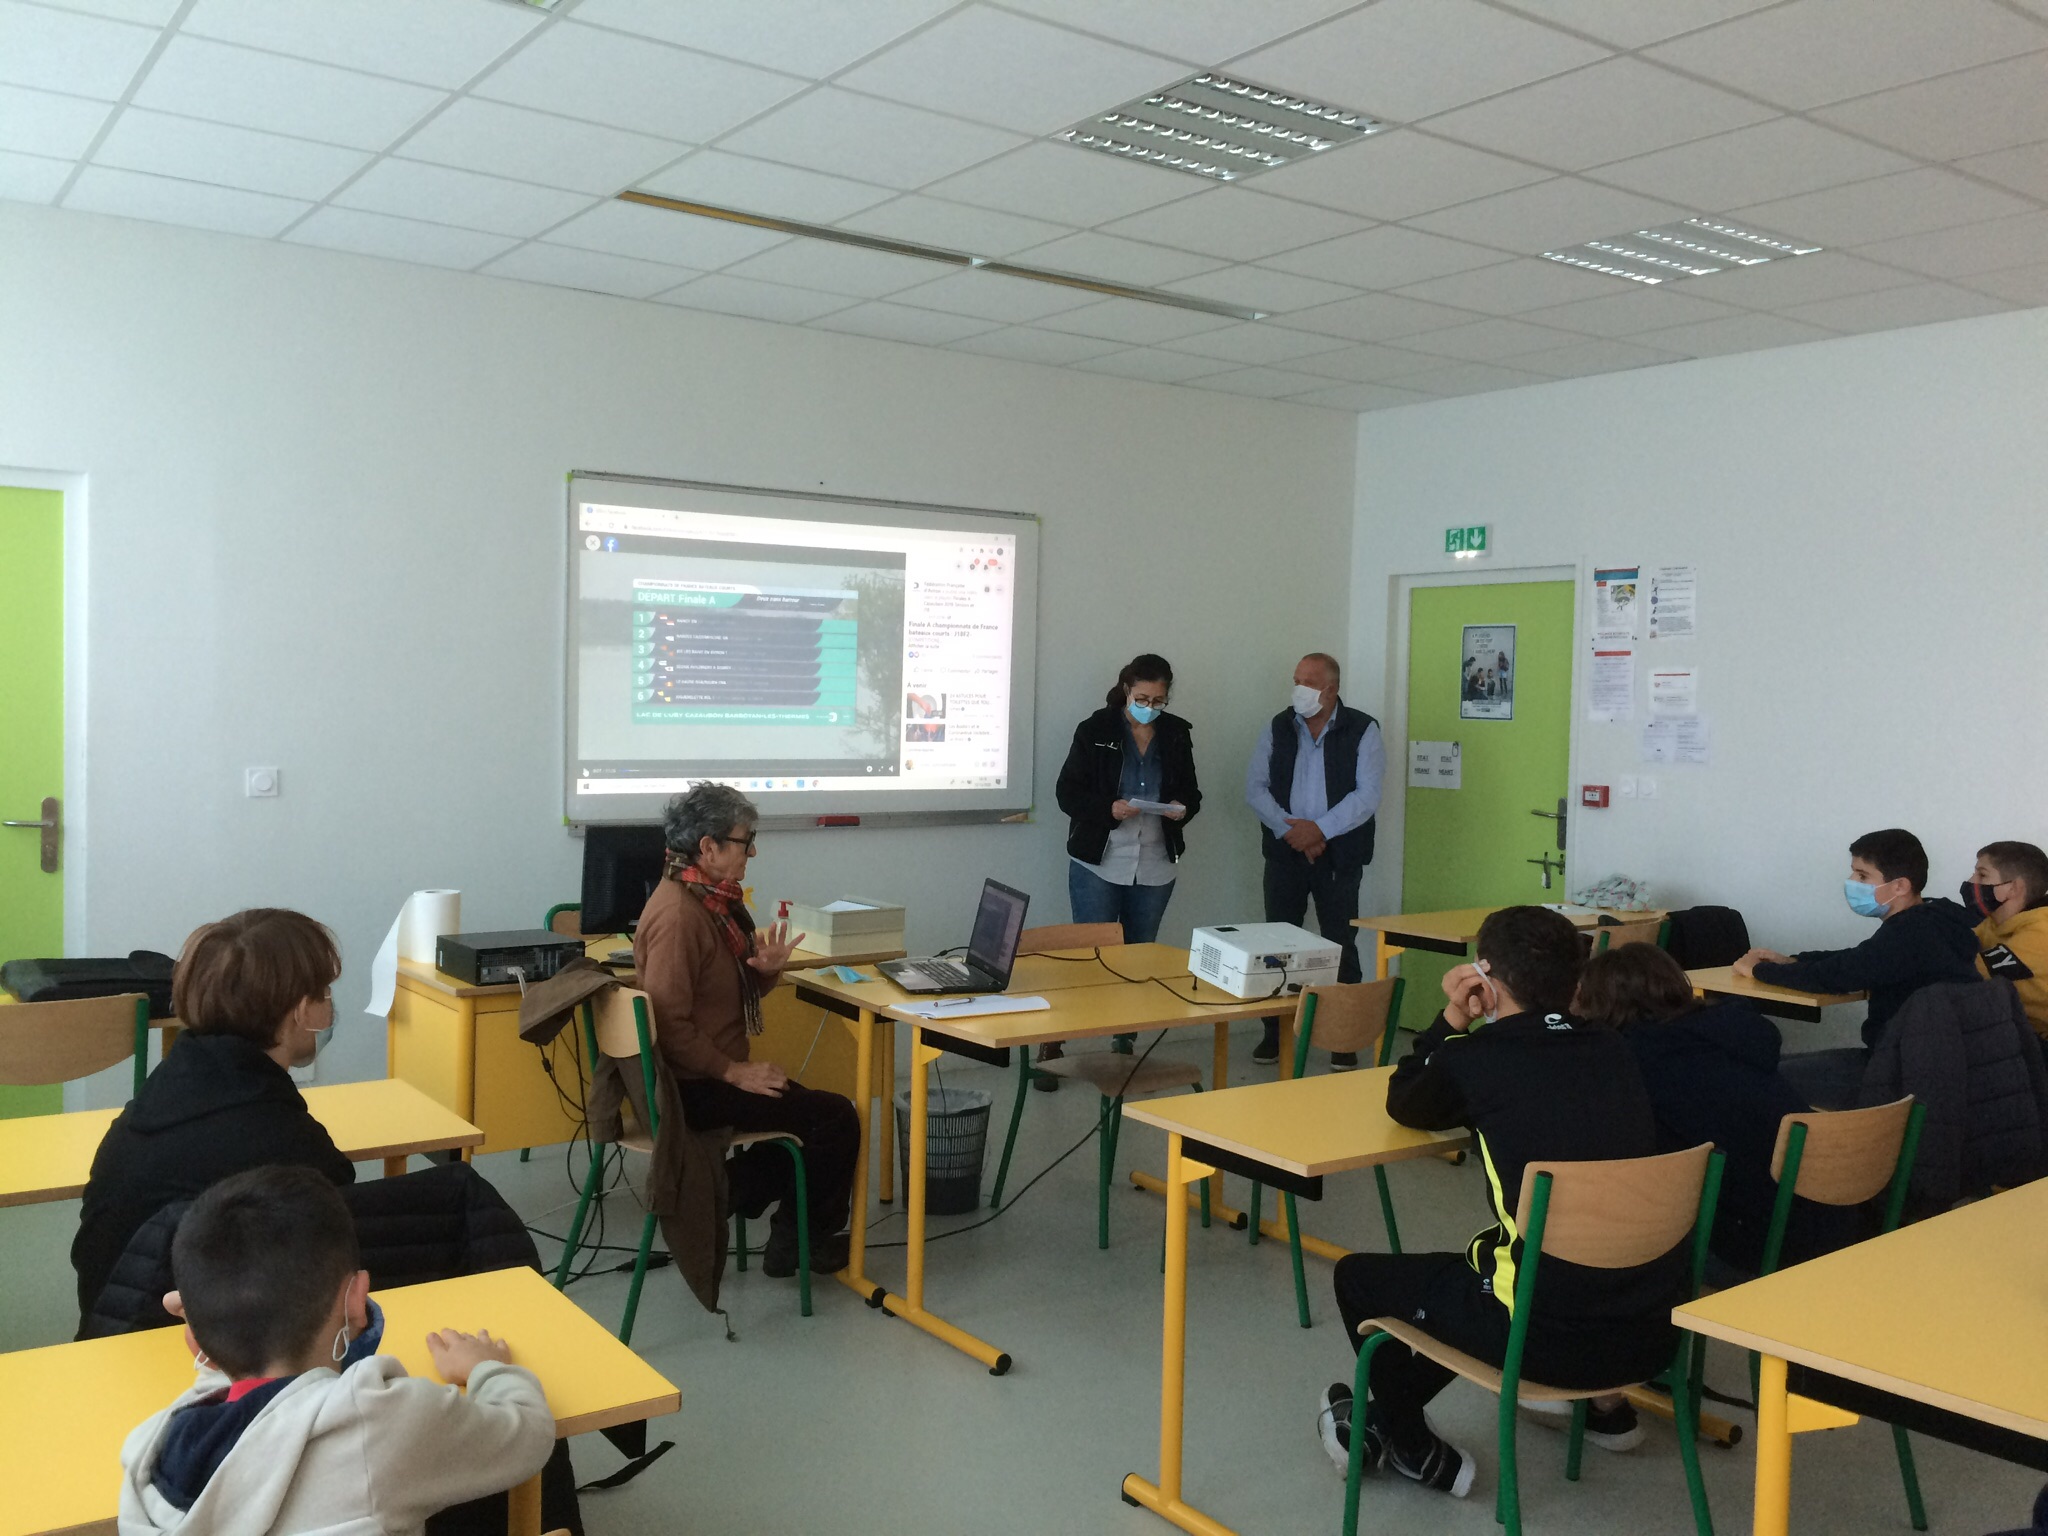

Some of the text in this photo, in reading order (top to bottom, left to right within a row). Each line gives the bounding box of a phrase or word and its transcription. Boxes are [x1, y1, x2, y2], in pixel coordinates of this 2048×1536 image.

[637, 589, 716, 606] DÉPART Finale A
[638, 613, 644, 622] 1
[932, 622, 971, 630] championnats
[638, 629, 645, 639] 2
[638, 644, 645, 654] 3
[637, 660, 645, 669] 4
[638, 676, 645, 686] 5
[637, 692, 644, 701] 6
[684, 712, 724, 720] CAZAUBON
